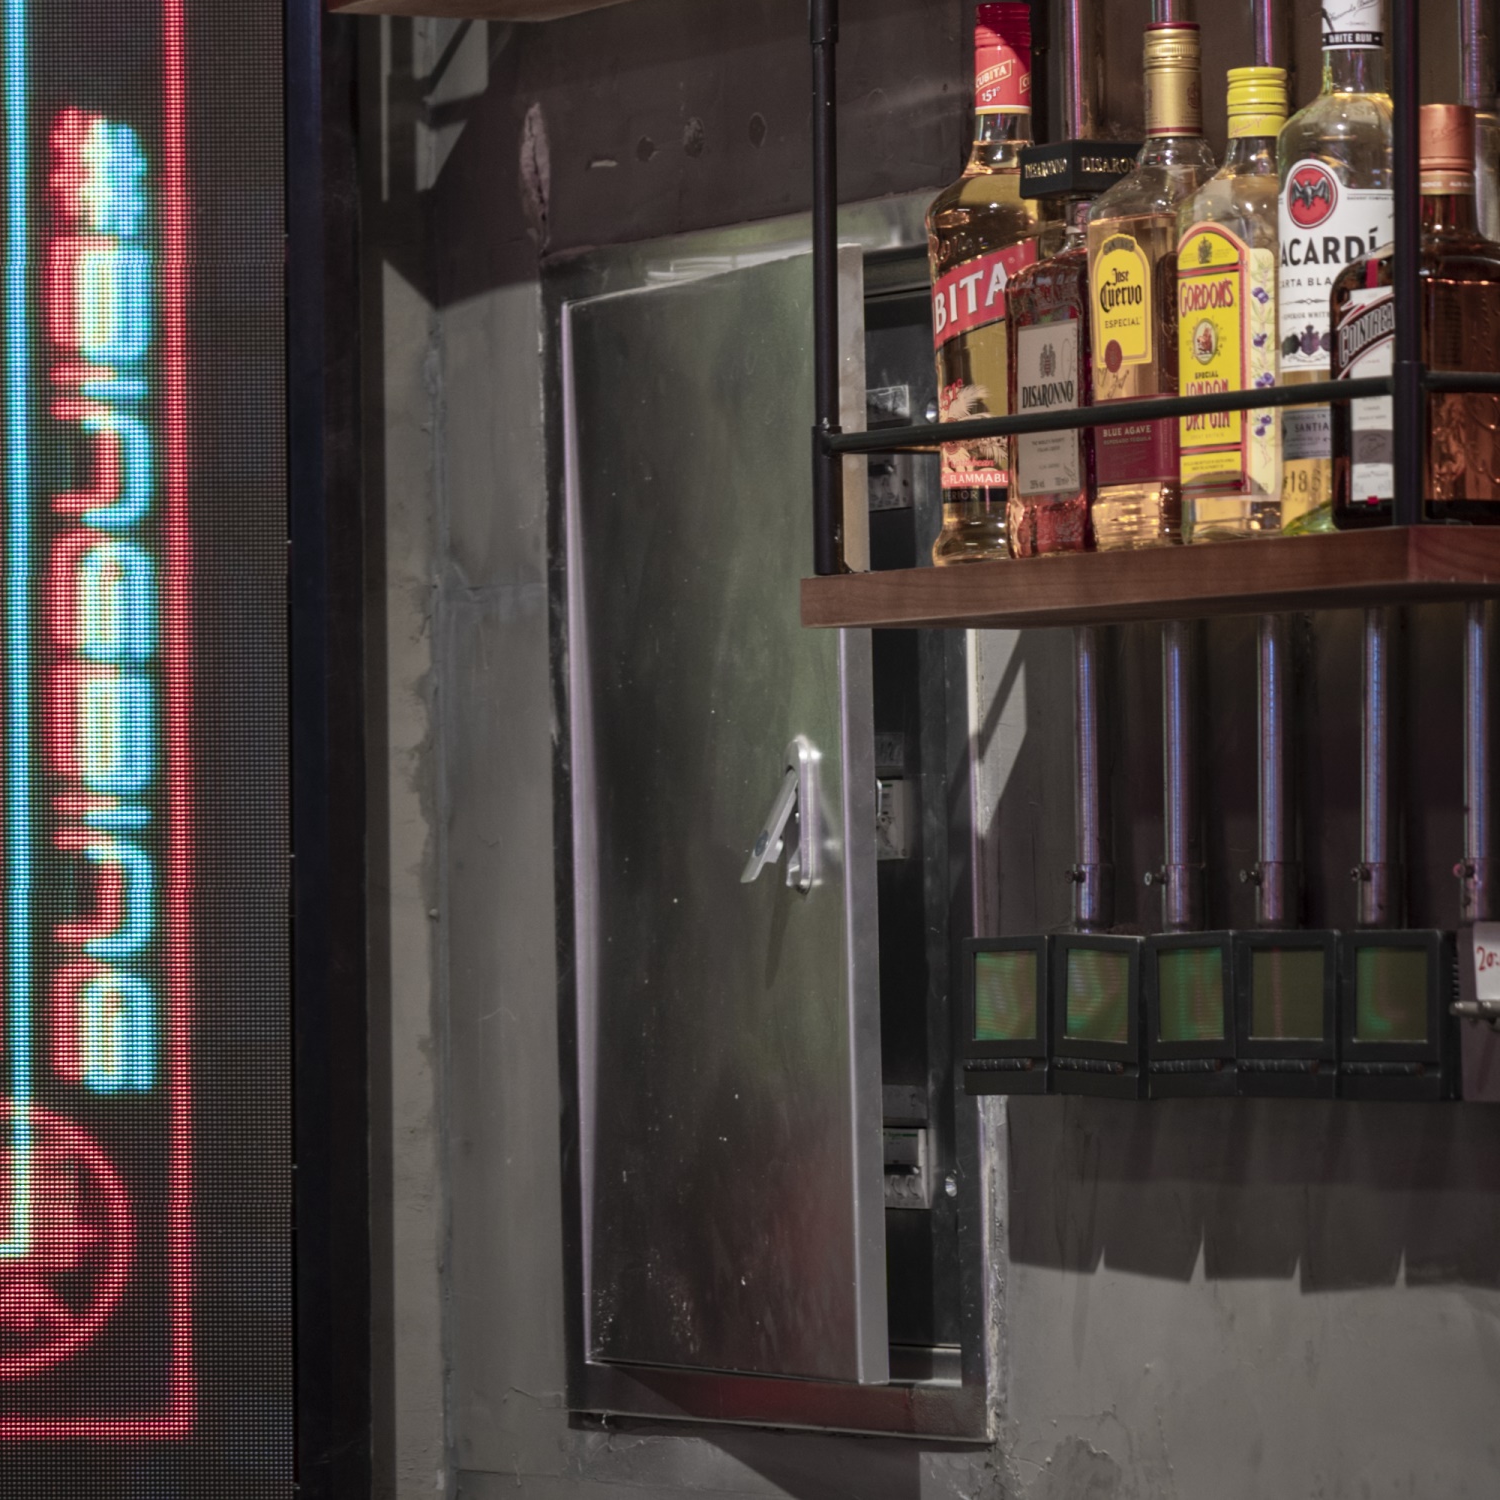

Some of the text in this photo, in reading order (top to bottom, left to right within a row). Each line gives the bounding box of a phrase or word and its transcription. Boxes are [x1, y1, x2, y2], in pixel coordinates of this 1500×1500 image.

[975, 65, 1007, 89] CUBITA
[1100, 281, 1143, 314] Cuervo
[1105, 317, 1141, 329] ESPECIAL
[1339, 302, 1394, 369] COINTREA
[1022, 380, 1074, 409] DISARONNO
[1103, 424, 1152, 438] BLUE AGAVE
